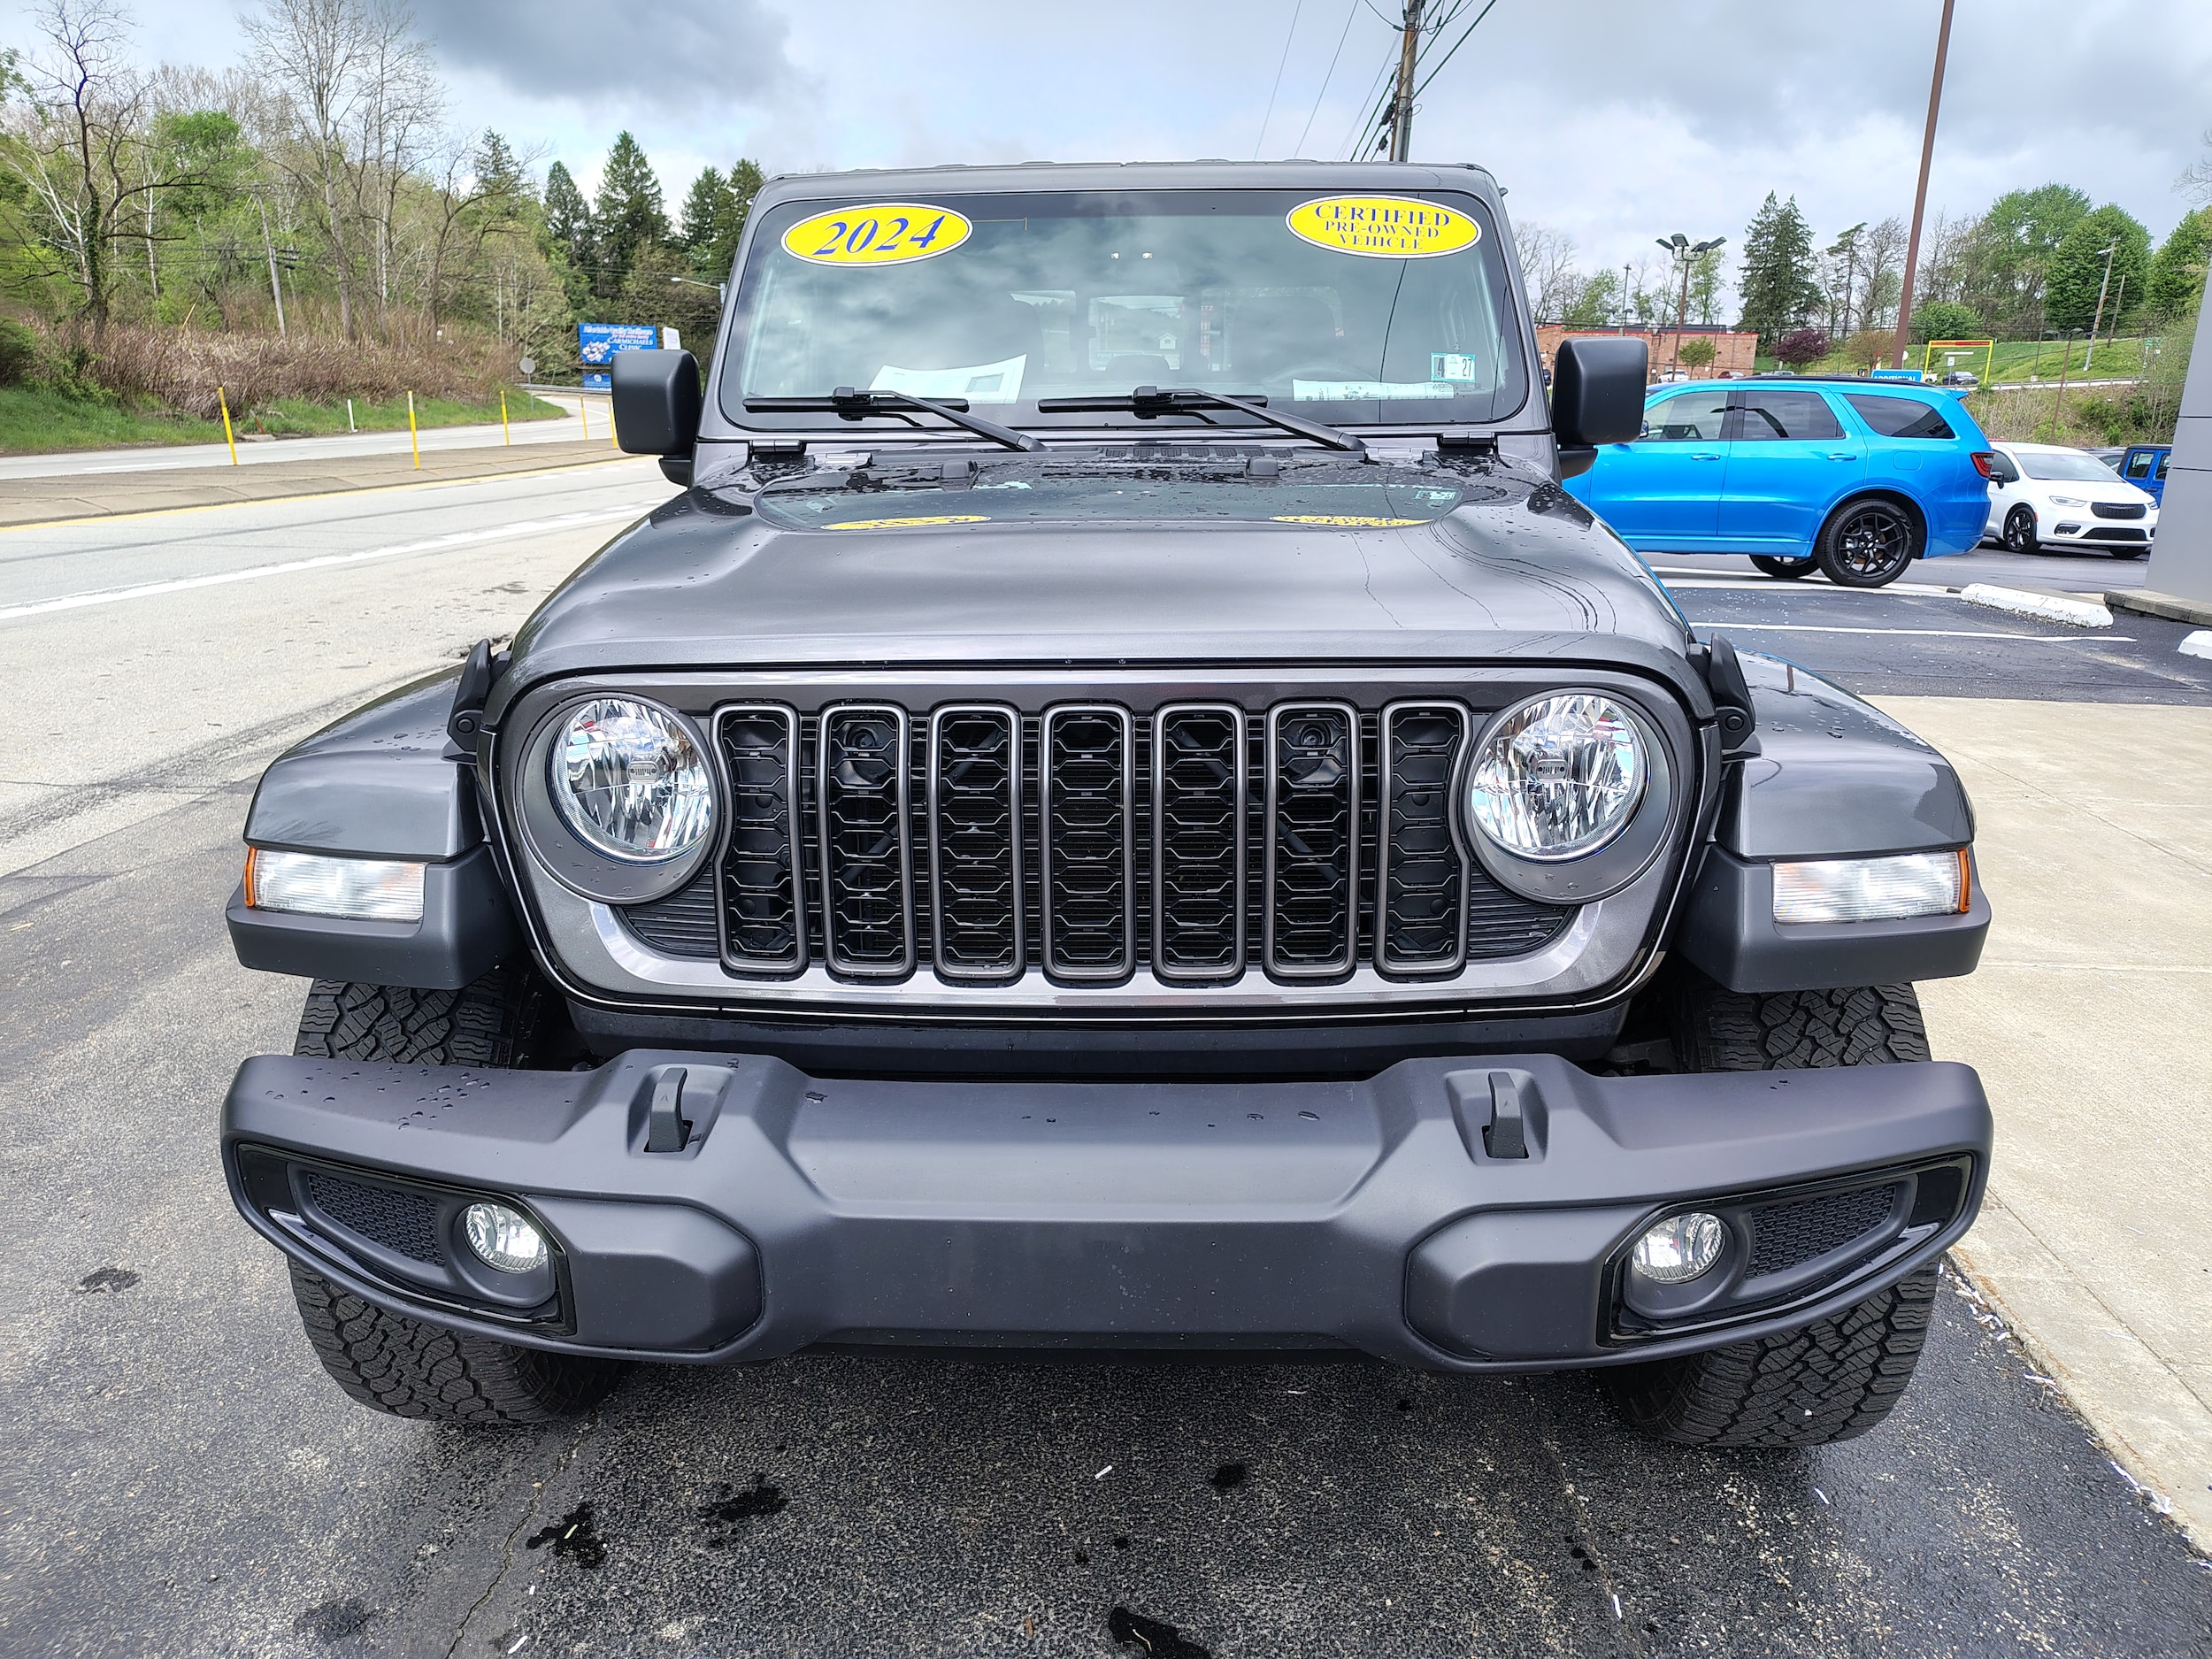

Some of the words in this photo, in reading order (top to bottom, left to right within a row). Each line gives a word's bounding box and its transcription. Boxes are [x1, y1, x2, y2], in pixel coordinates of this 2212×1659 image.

[1315, 204, 1450, 227] CERTIFIED
[812, 215, 946, 256] 2024
[1325, 220, 1440, 238] PRE-OWNED
[1339, 234, 1424, 250] VEHICLE
[1462, 358, 1472, 378] 27
